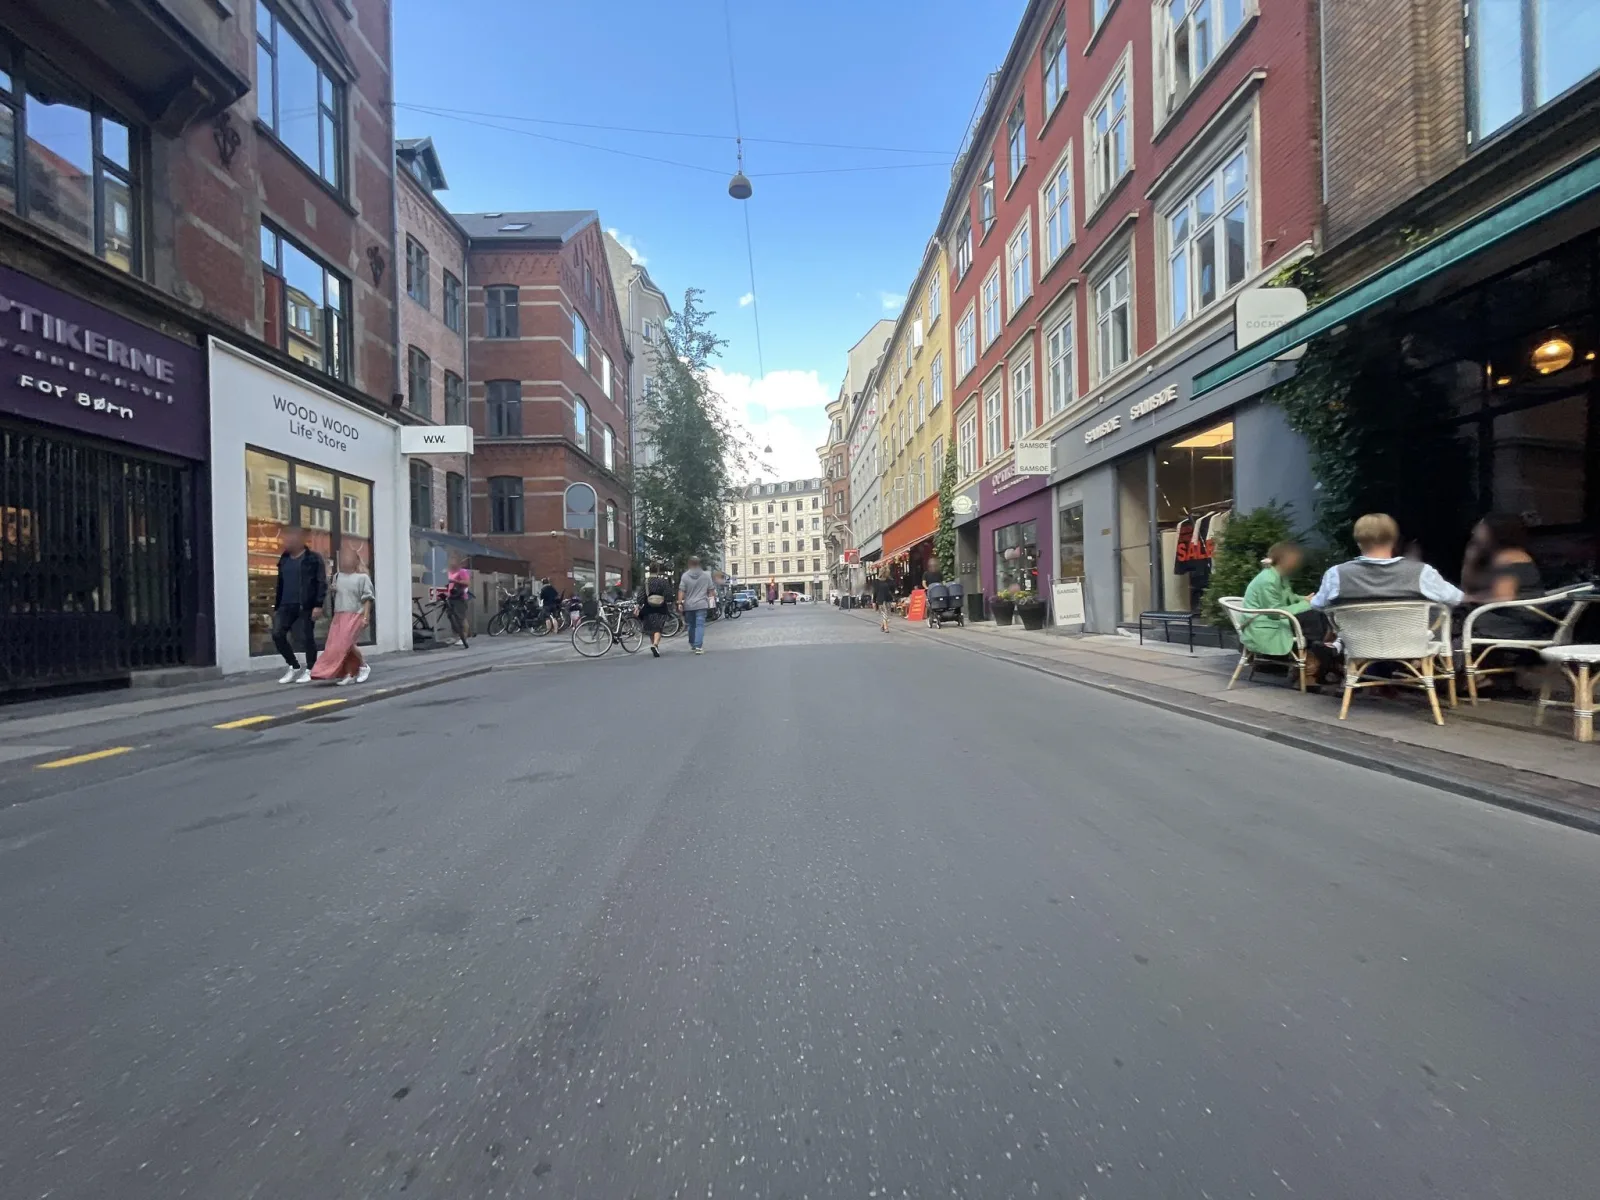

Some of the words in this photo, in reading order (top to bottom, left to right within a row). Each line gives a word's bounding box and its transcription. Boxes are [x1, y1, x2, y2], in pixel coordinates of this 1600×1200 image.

[273, 394, 317, 424] WOOD
[322, 415, 359, 440] WOOD
[317, 430, 347, 452] Store
[423, 435, 446, 444] W.W.
